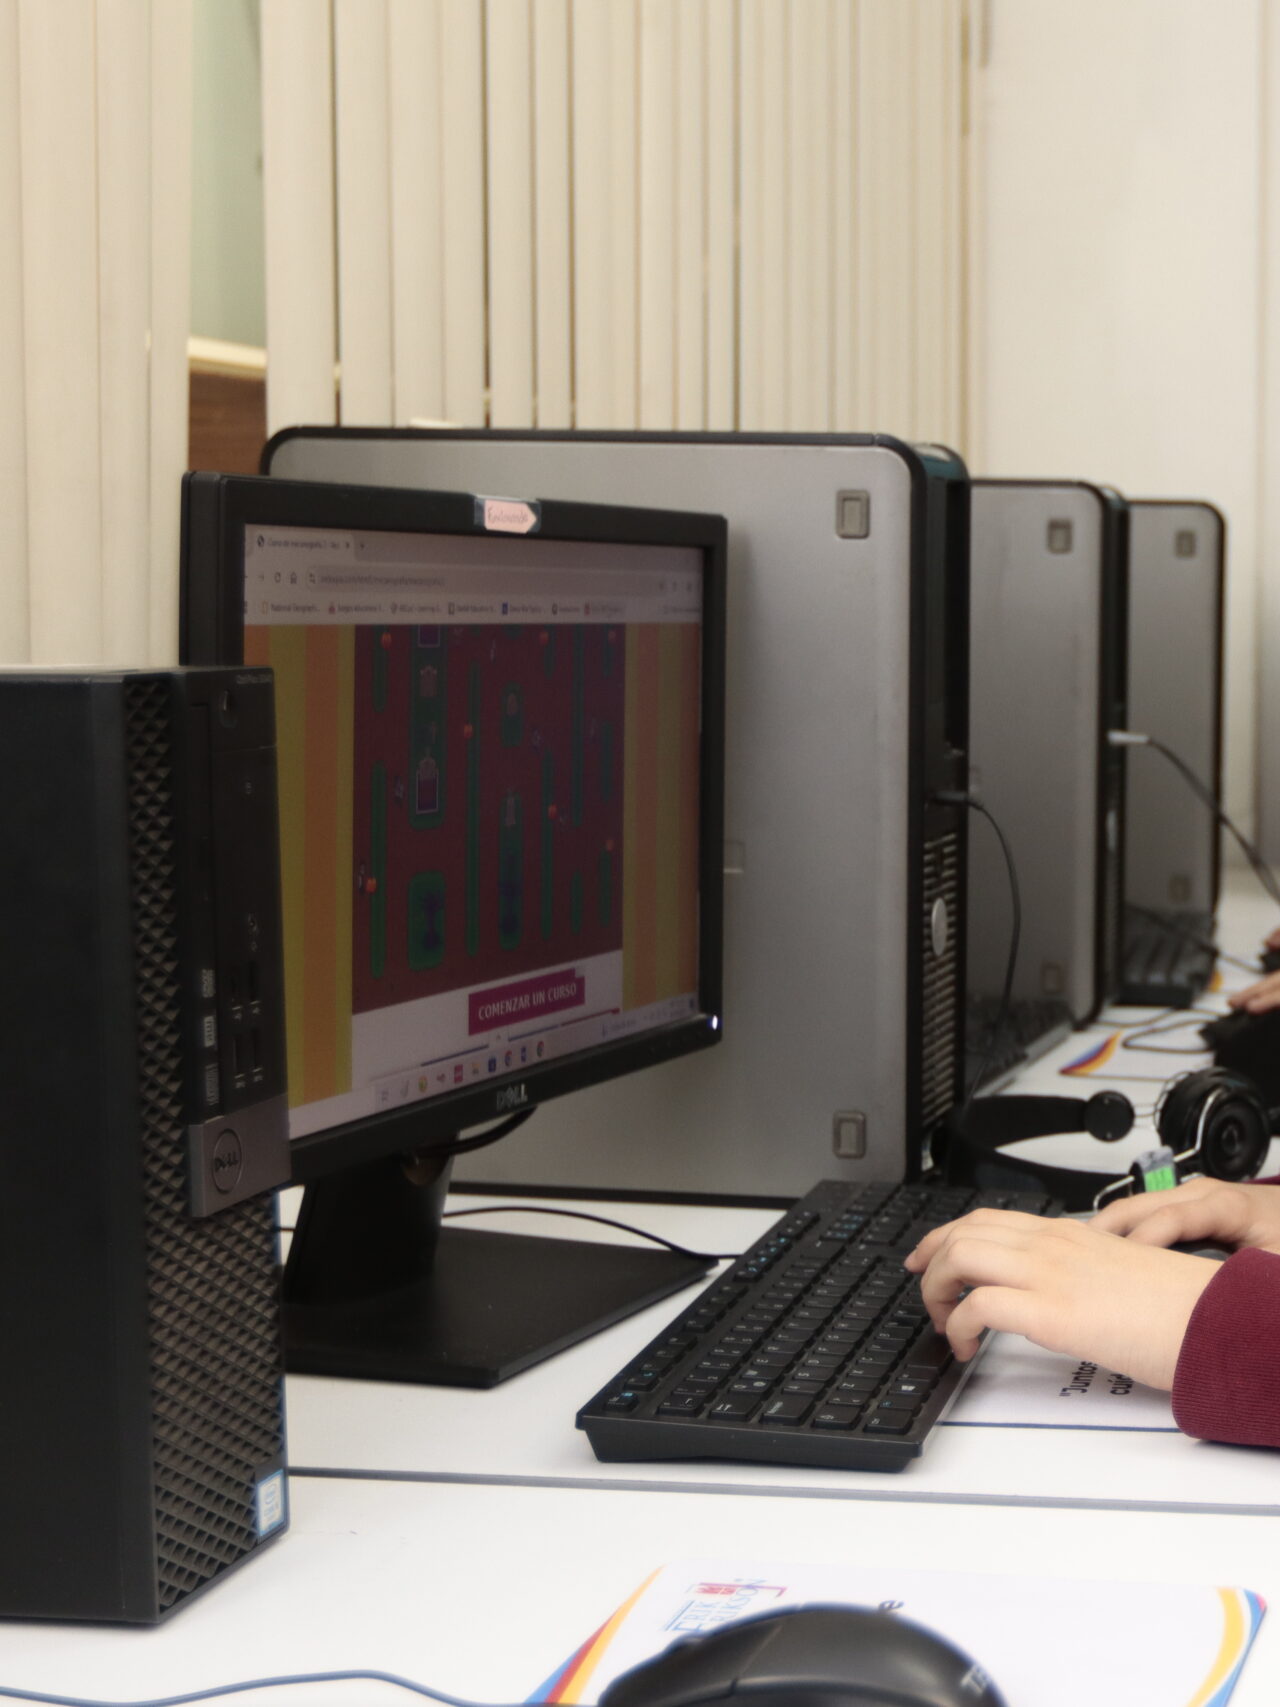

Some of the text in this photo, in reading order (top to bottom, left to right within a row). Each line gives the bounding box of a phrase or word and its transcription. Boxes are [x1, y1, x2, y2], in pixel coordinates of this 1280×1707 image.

[478, 982, 577, 1020] COMENZAR UN CURSO
